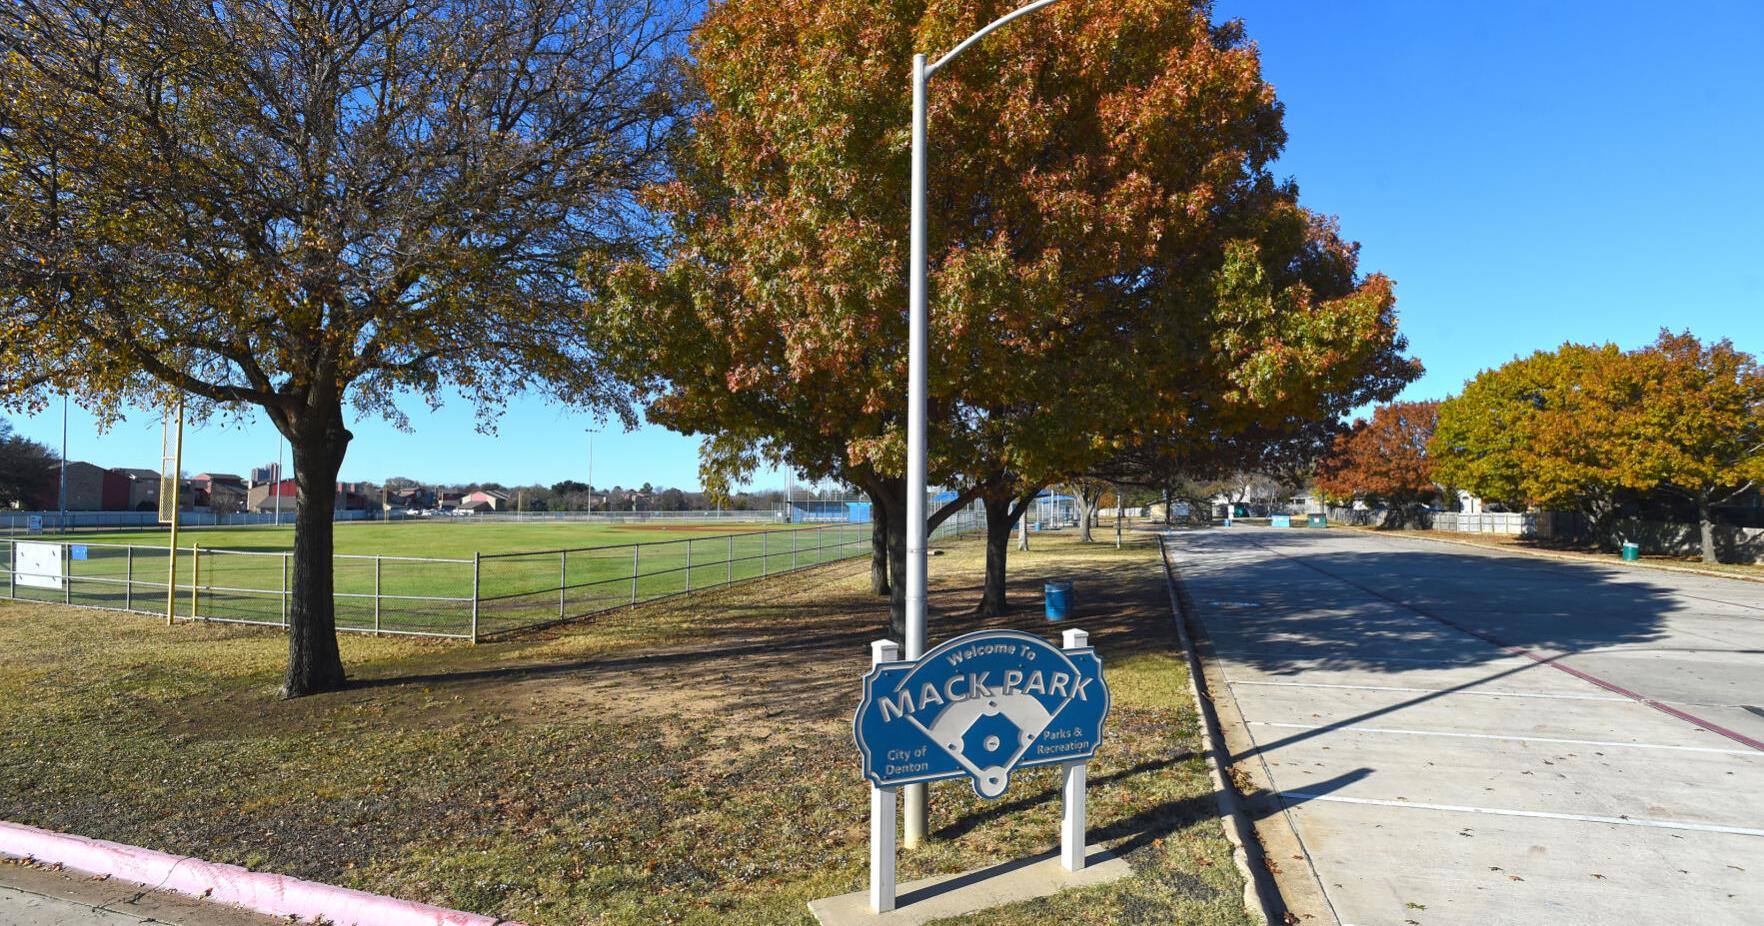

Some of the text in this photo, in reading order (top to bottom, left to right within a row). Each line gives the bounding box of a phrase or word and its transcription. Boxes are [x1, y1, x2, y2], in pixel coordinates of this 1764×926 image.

[947, 643, 1036, 666] Welcome To
[878, 670, 1093, 722] MACK PARK
[1043, 726, 1084, 741] Parks &
[887, 747, 928, 762] City of
[1036, 739, 1090, 755] Recreation
[886, 762, 928, 774] Denton
